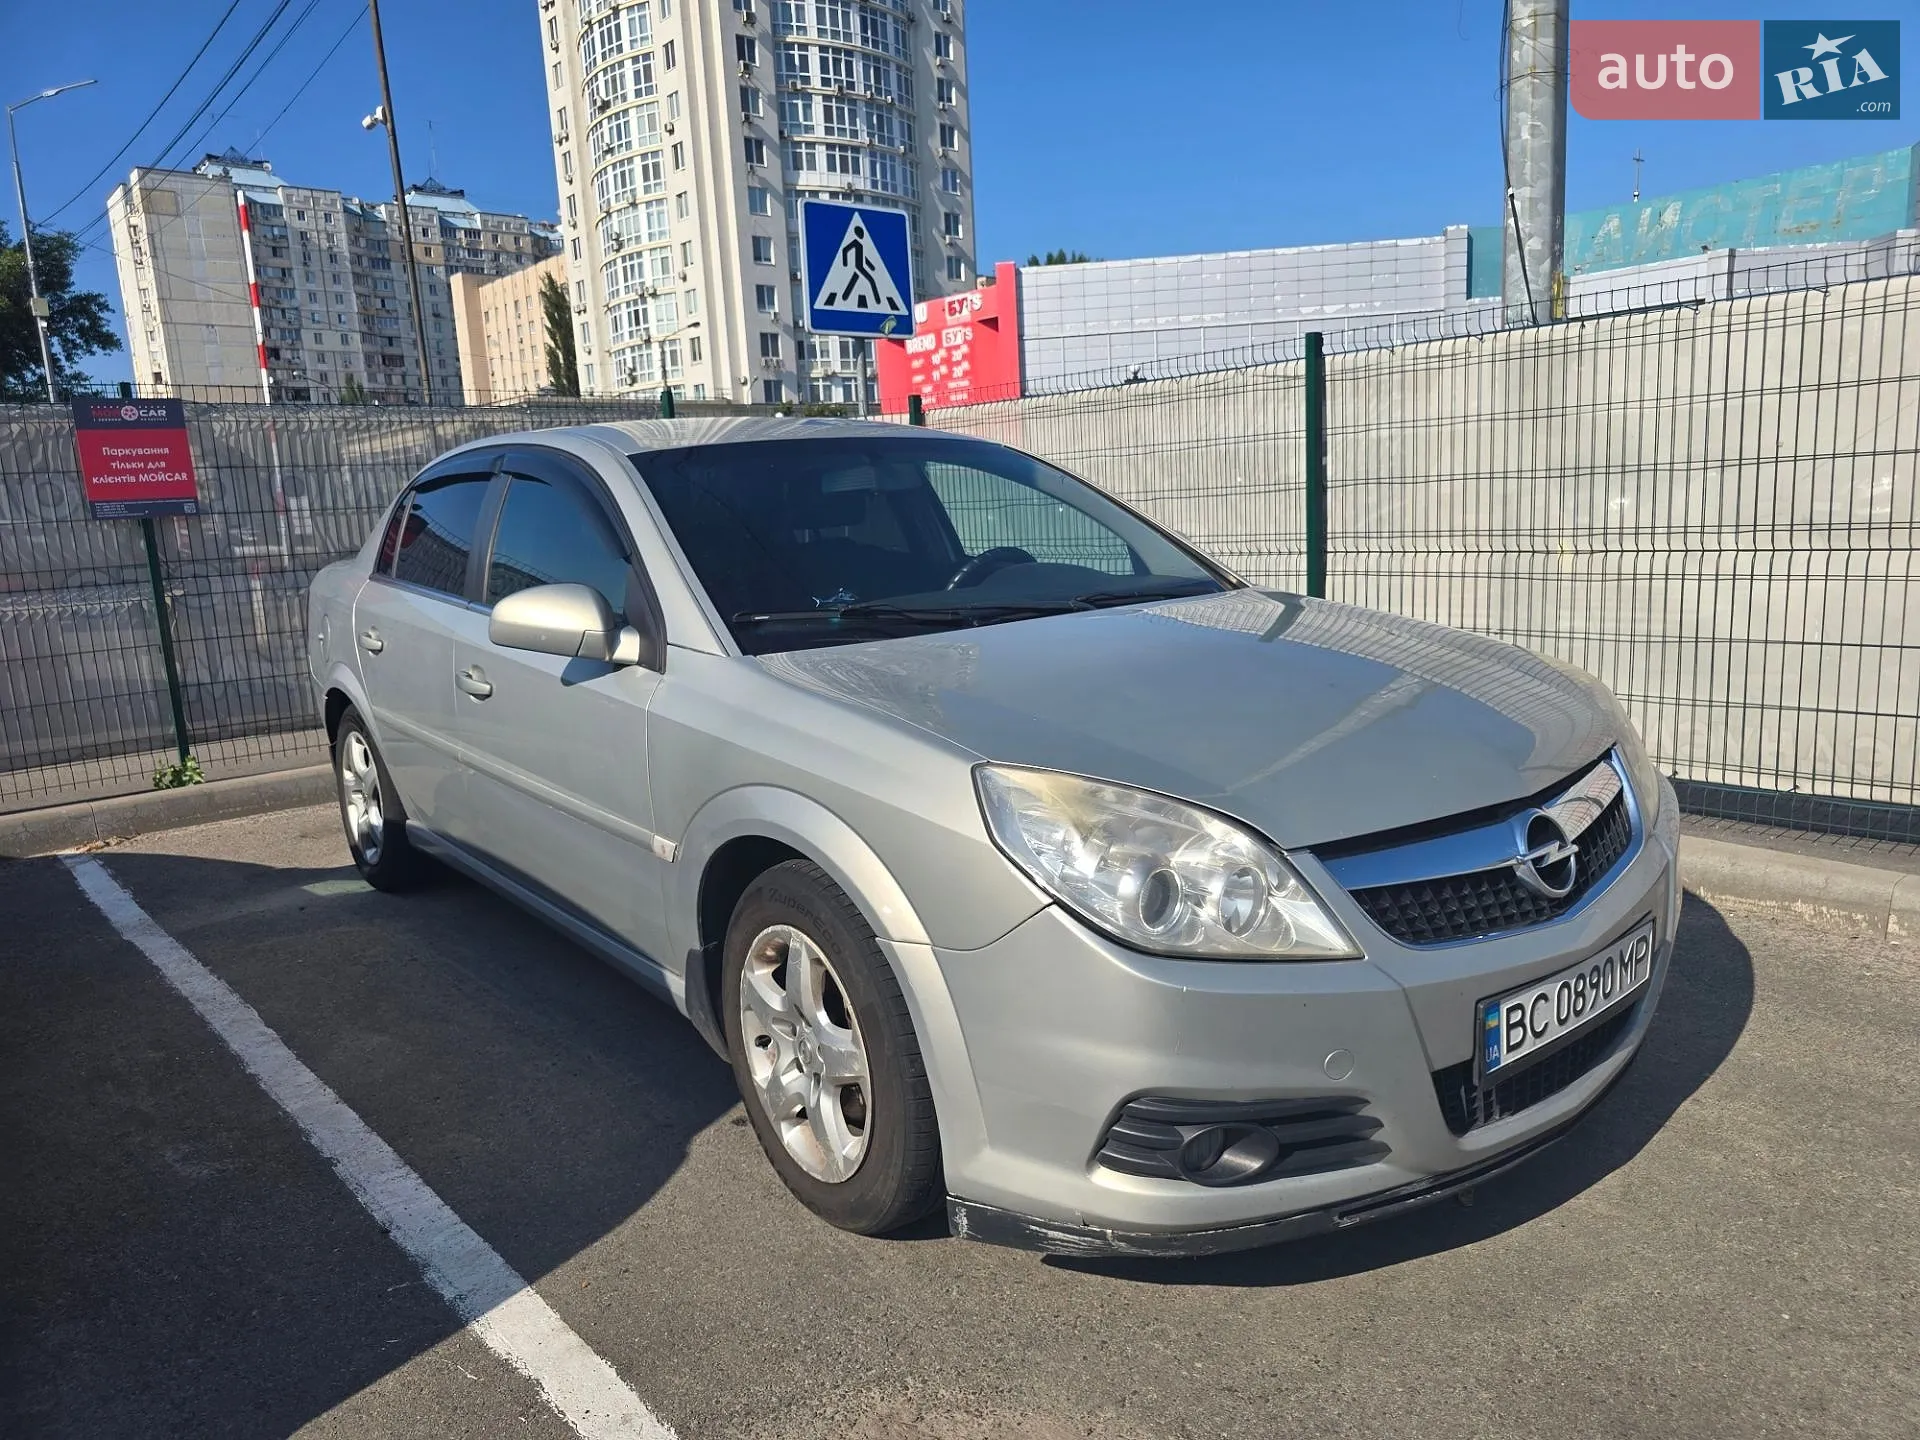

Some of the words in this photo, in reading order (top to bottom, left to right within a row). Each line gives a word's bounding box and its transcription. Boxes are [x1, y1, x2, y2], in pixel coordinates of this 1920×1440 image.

[102, 446, 170, 457] Паркування
[111, 460, 144, 470] тільки
[147, 461, 166, 469] для
[92, 473, 136, 484] клієнтів
[1505, 992, 1549, 1055] BC
[1555, 956, 1614, 1026] 0890
[1617, 934, 1648, 993] MP
[1485, 1045, 1500, 1063] UA
